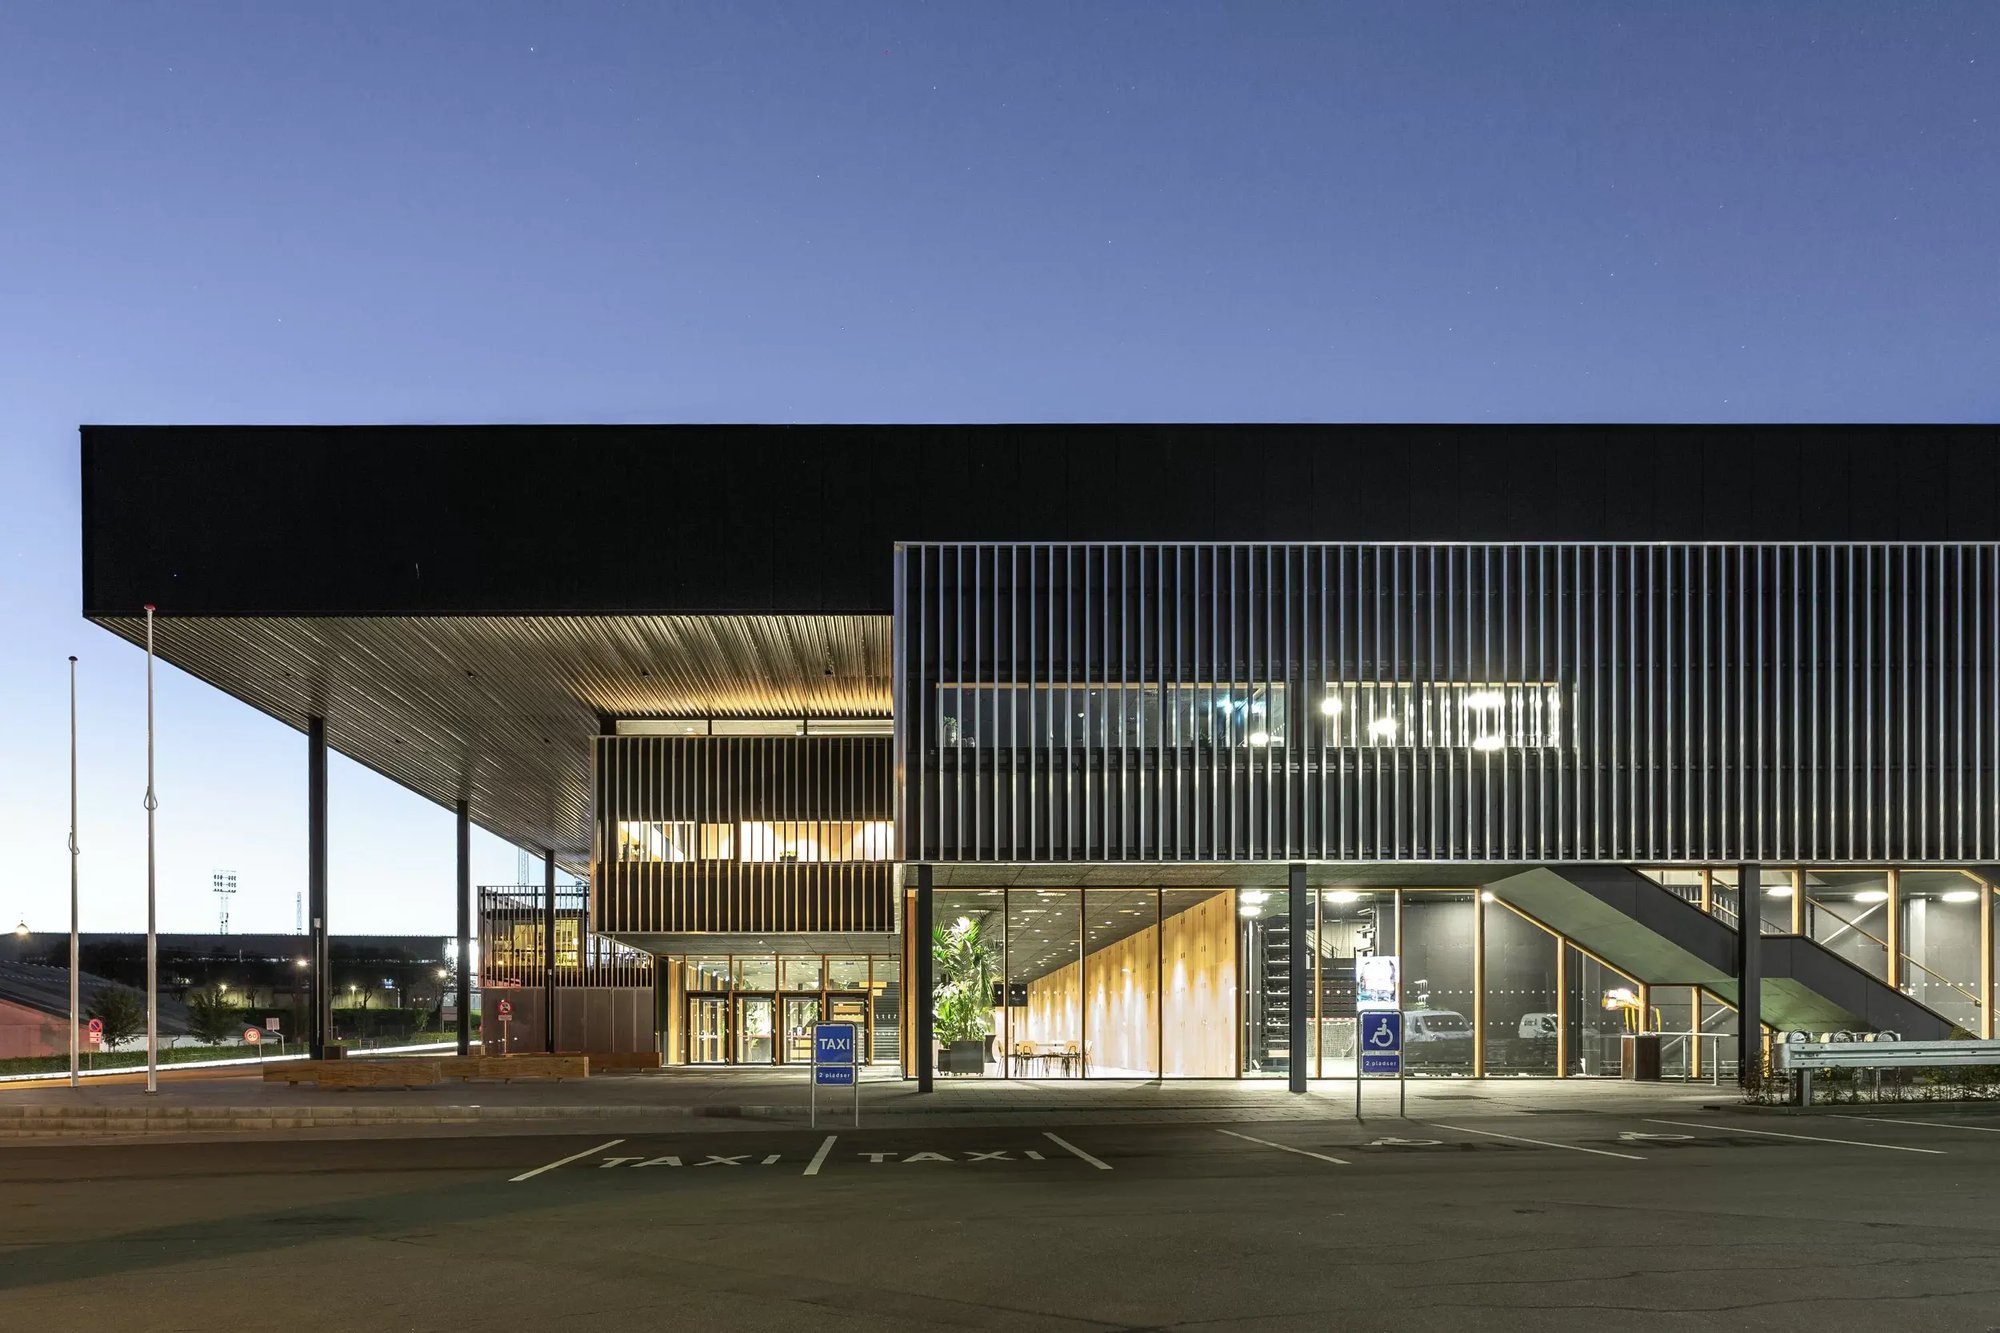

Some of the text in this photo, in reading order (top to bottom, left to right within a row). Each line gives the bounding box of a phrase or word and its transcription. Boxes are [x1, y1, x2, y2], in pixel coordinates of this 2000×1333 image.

[819, 1039, 850, 1050] TAXI
[599, 1154, 781, 1168] TAXI
[857, 1150, 1046, 1163] TAXI
